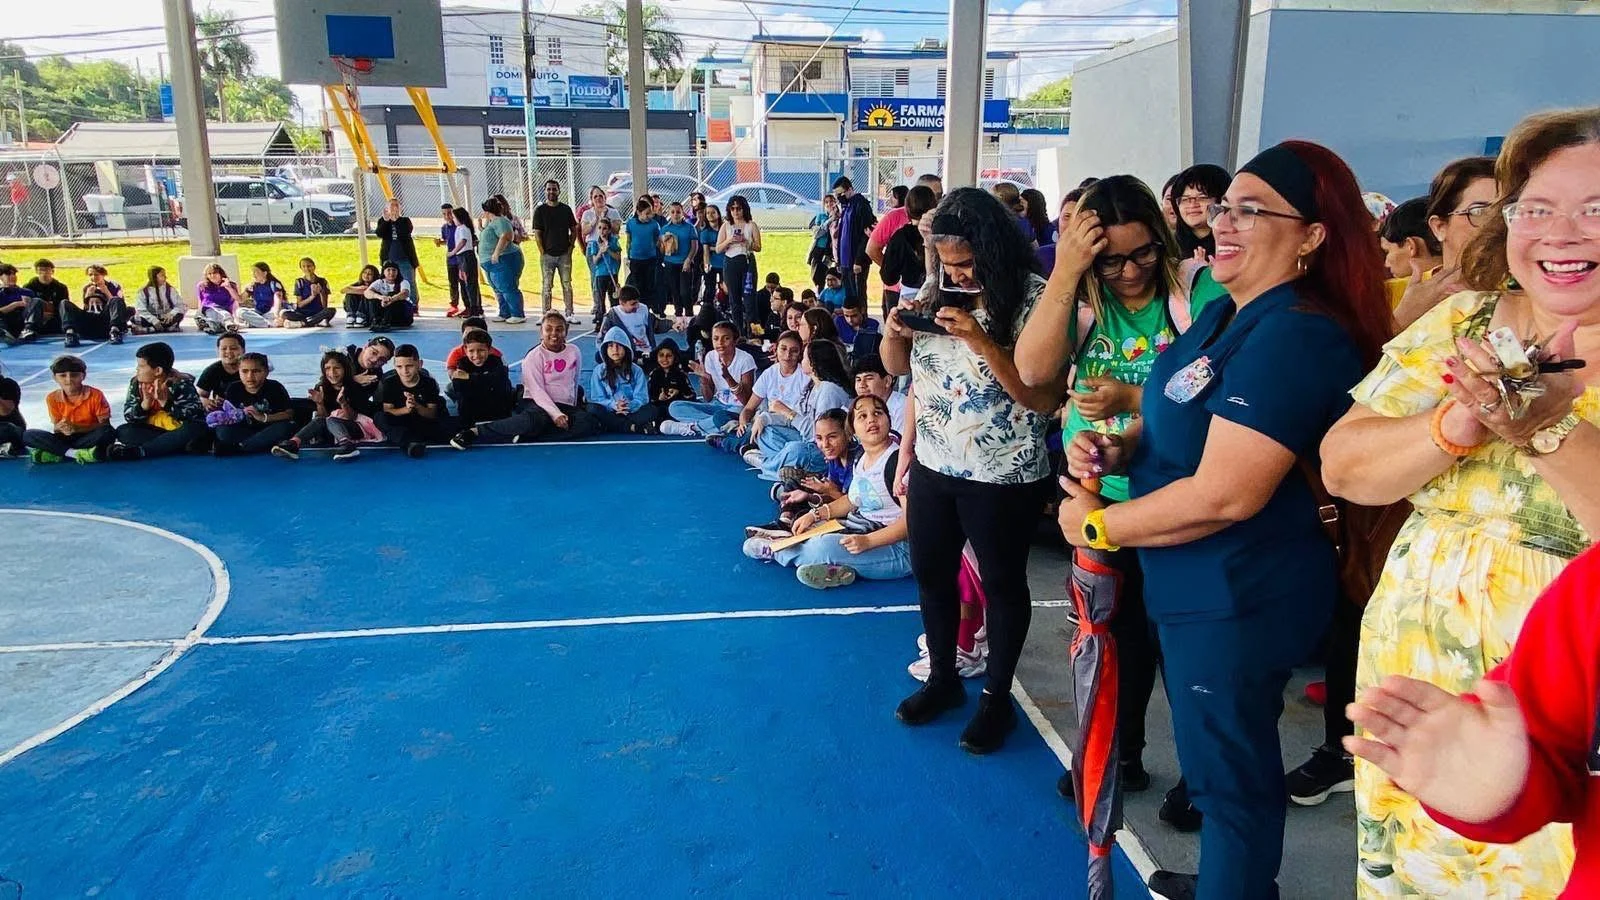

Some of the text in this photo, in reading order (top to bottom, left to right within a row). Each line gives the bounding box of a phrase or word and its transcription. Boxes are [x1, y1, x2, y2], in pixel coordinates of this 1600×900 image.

[496, 71, 559, 80] DOMIUITO
[570, 84, 611, 96] TOLEDO
[900, 105, 945, 116] FARMA
[900, 117, 944, 128] DOMING
[491, 127, 568, 136] Bienvnidos
